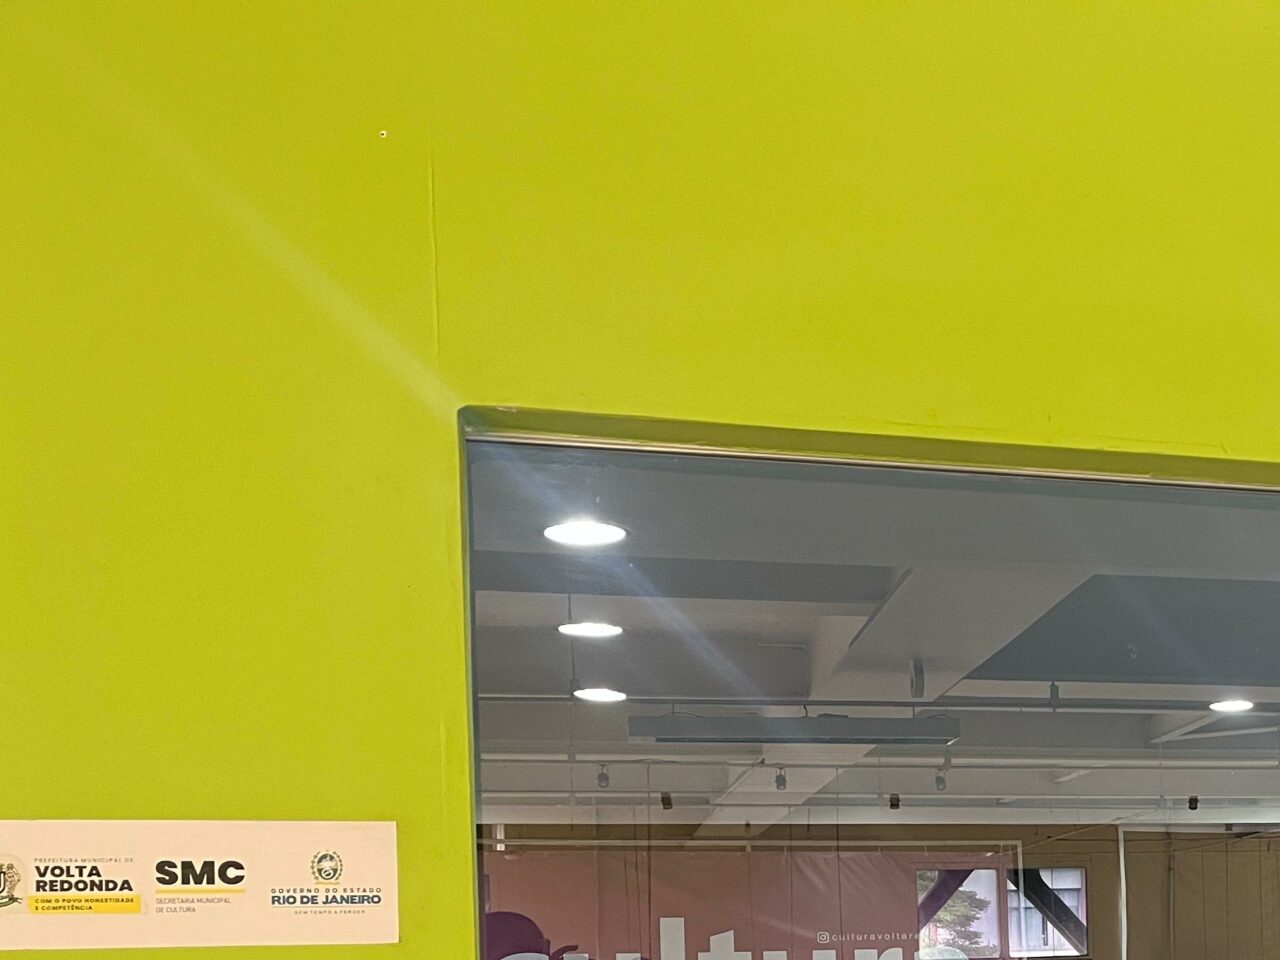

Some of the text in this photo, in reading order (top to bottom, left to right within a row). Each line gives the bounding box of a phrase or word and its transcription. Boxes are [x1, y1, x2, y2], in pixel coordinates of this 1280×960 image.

[35, 866, 102, 877] VOLTA
[156, 860, 245, 885] SMC
[35, 880, 134, 892] REDONDA
[272, 895, 382, 905] RIO DE JANEIRO
